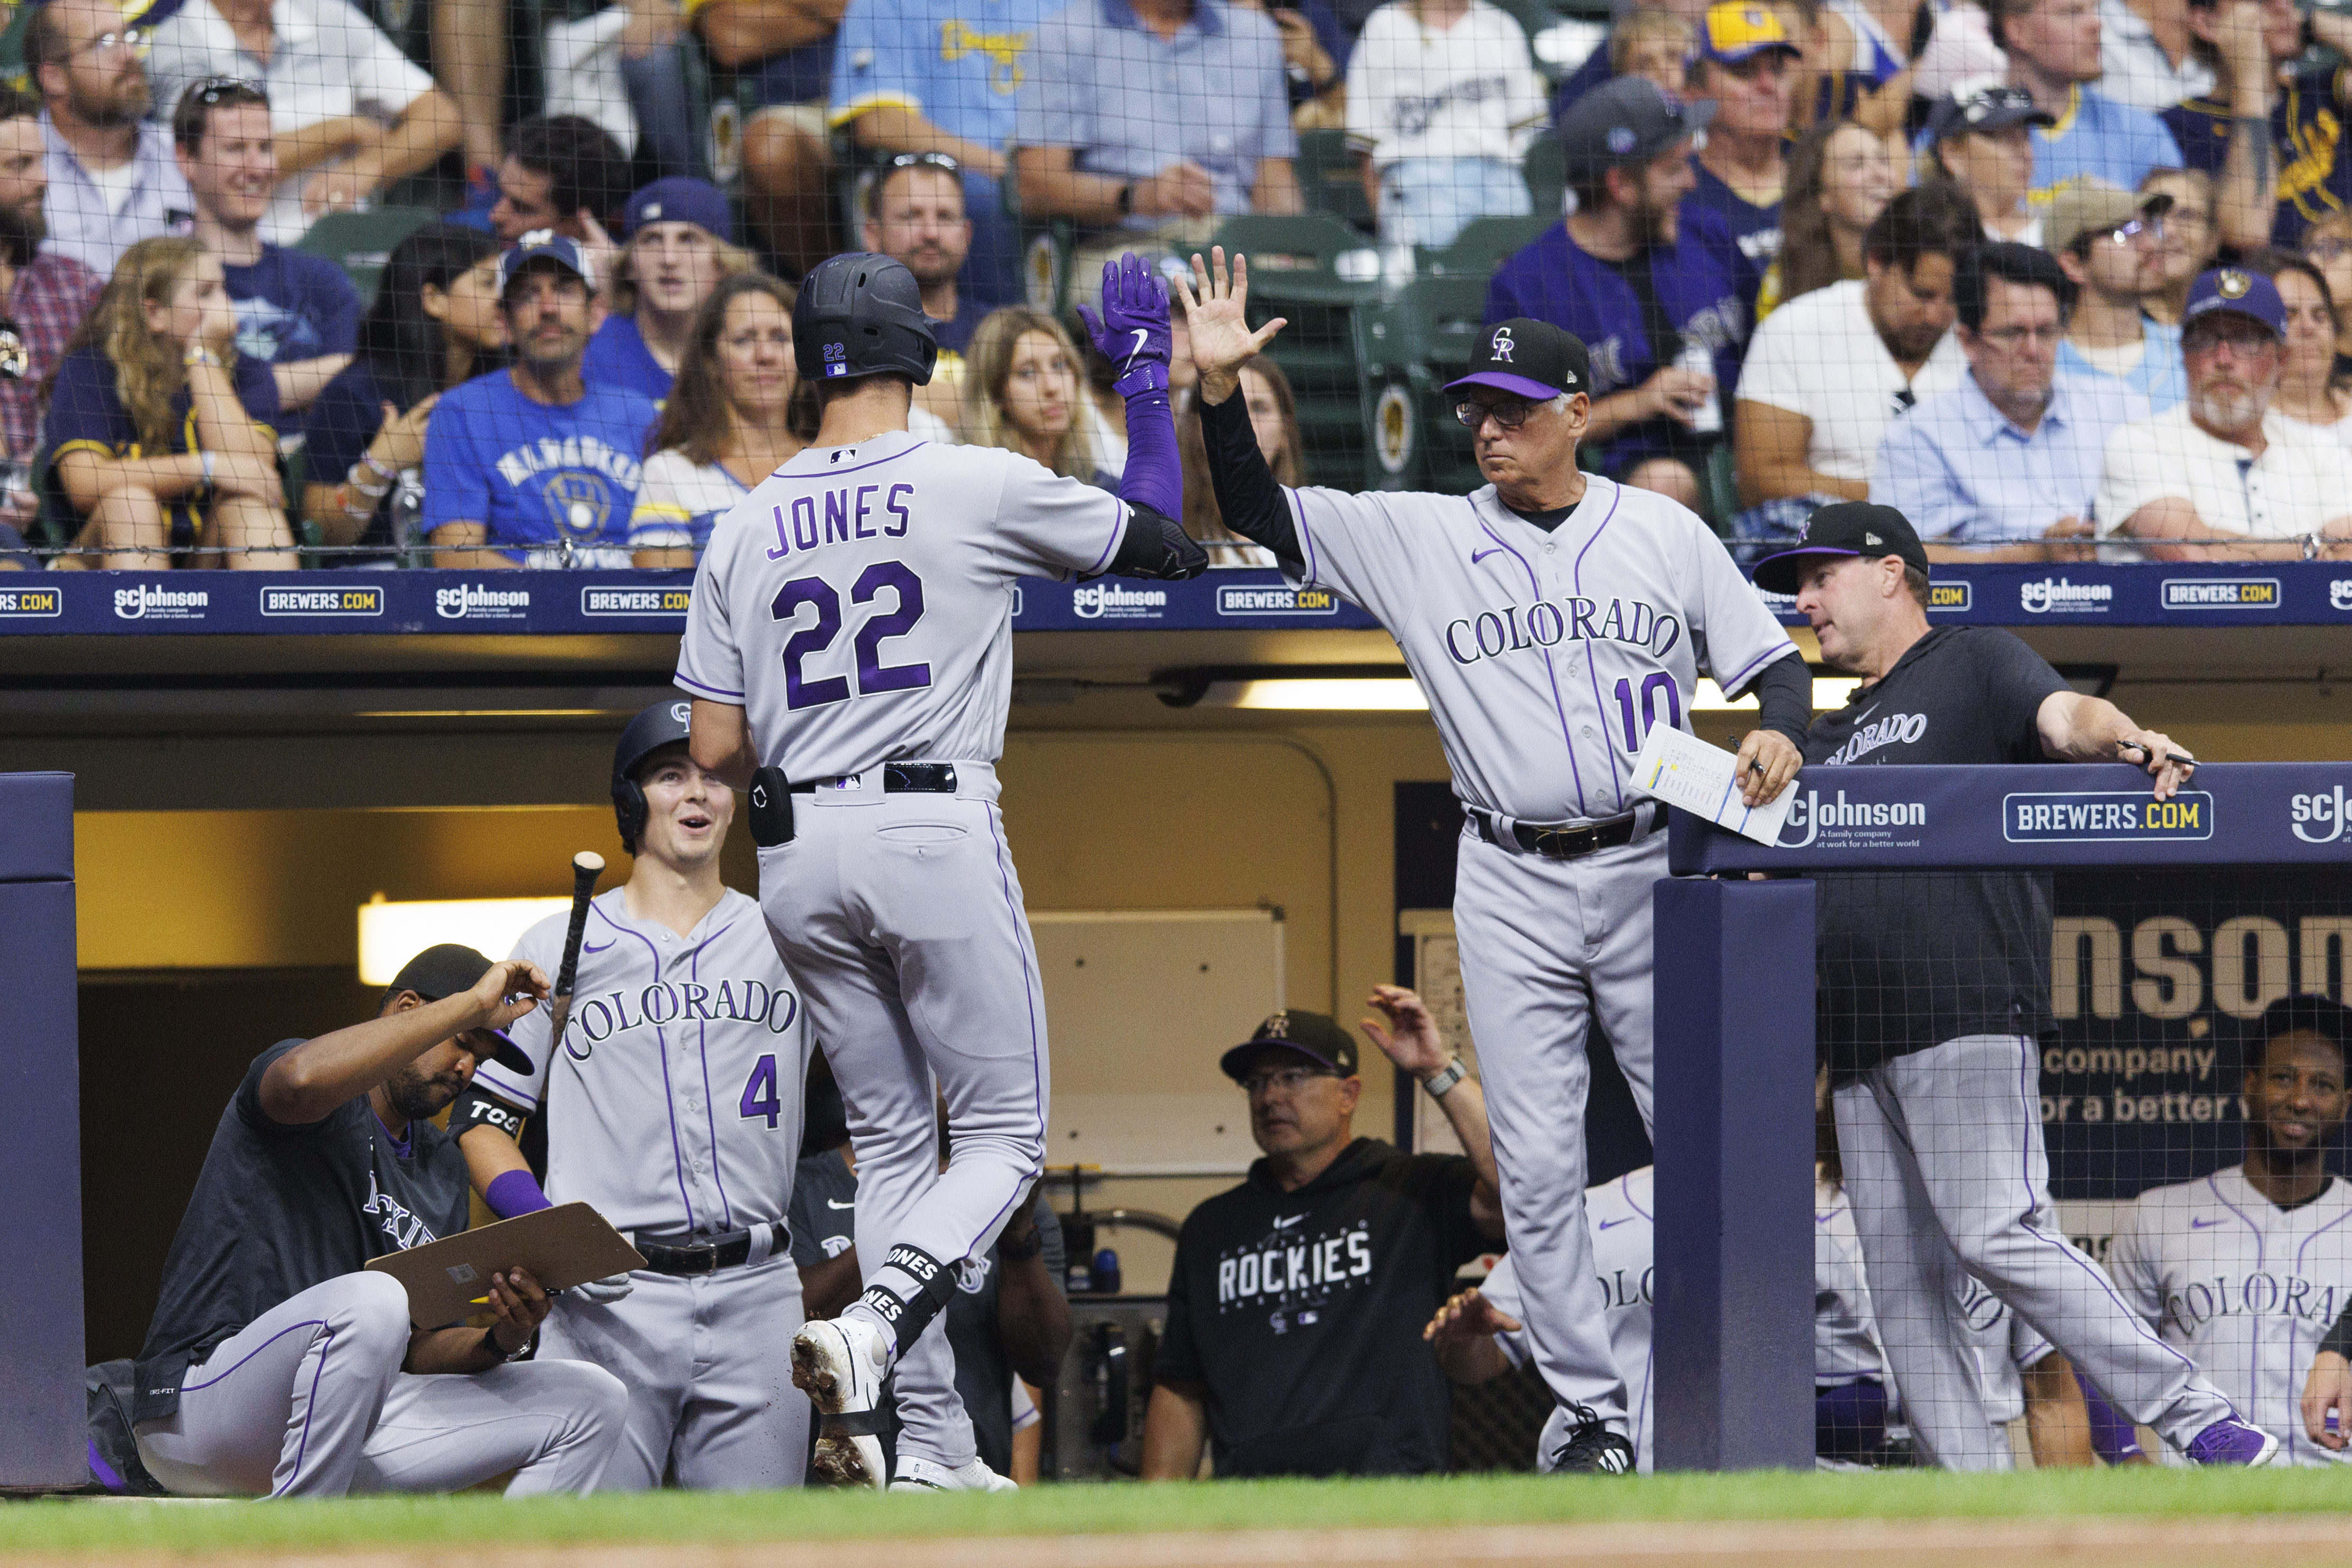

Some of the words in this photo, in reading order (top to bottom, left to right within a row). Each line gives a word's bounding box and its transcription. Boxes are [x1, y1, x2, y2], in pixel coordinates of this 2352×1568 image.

[823, 342, 845, 361] 22
[766, 481, 916, 563] JONES
[268, 593, 375, 609] BREWERS.COM
[1225, 591, 1330, 609] BREWERS.COM
[2170, 585, 2273, 603] BREWERS.COM
[769, 559, 935, 713] 22
[1445, 595, 1681, 665] COLORADO
[1613, 671, 1682, 754] 10
[2018, 804, 2199, 830] BREWERS.COM
[563, 978, 799, 1062] COLORADO
[2043, 1047, 2217, 1081] company
[739, 1053, 781, 1131] 4
[2040, 1095, 2072, 1122] or
[2082, 1096, 2104, 1122] a
[2114, 1086, 2228, 1122] better
[884, 1248, 938, 1280] ONES
[1218, 1230, 1371, 1304] ROCKIES
[2169, 1272, 2335, 1338] COLORA
